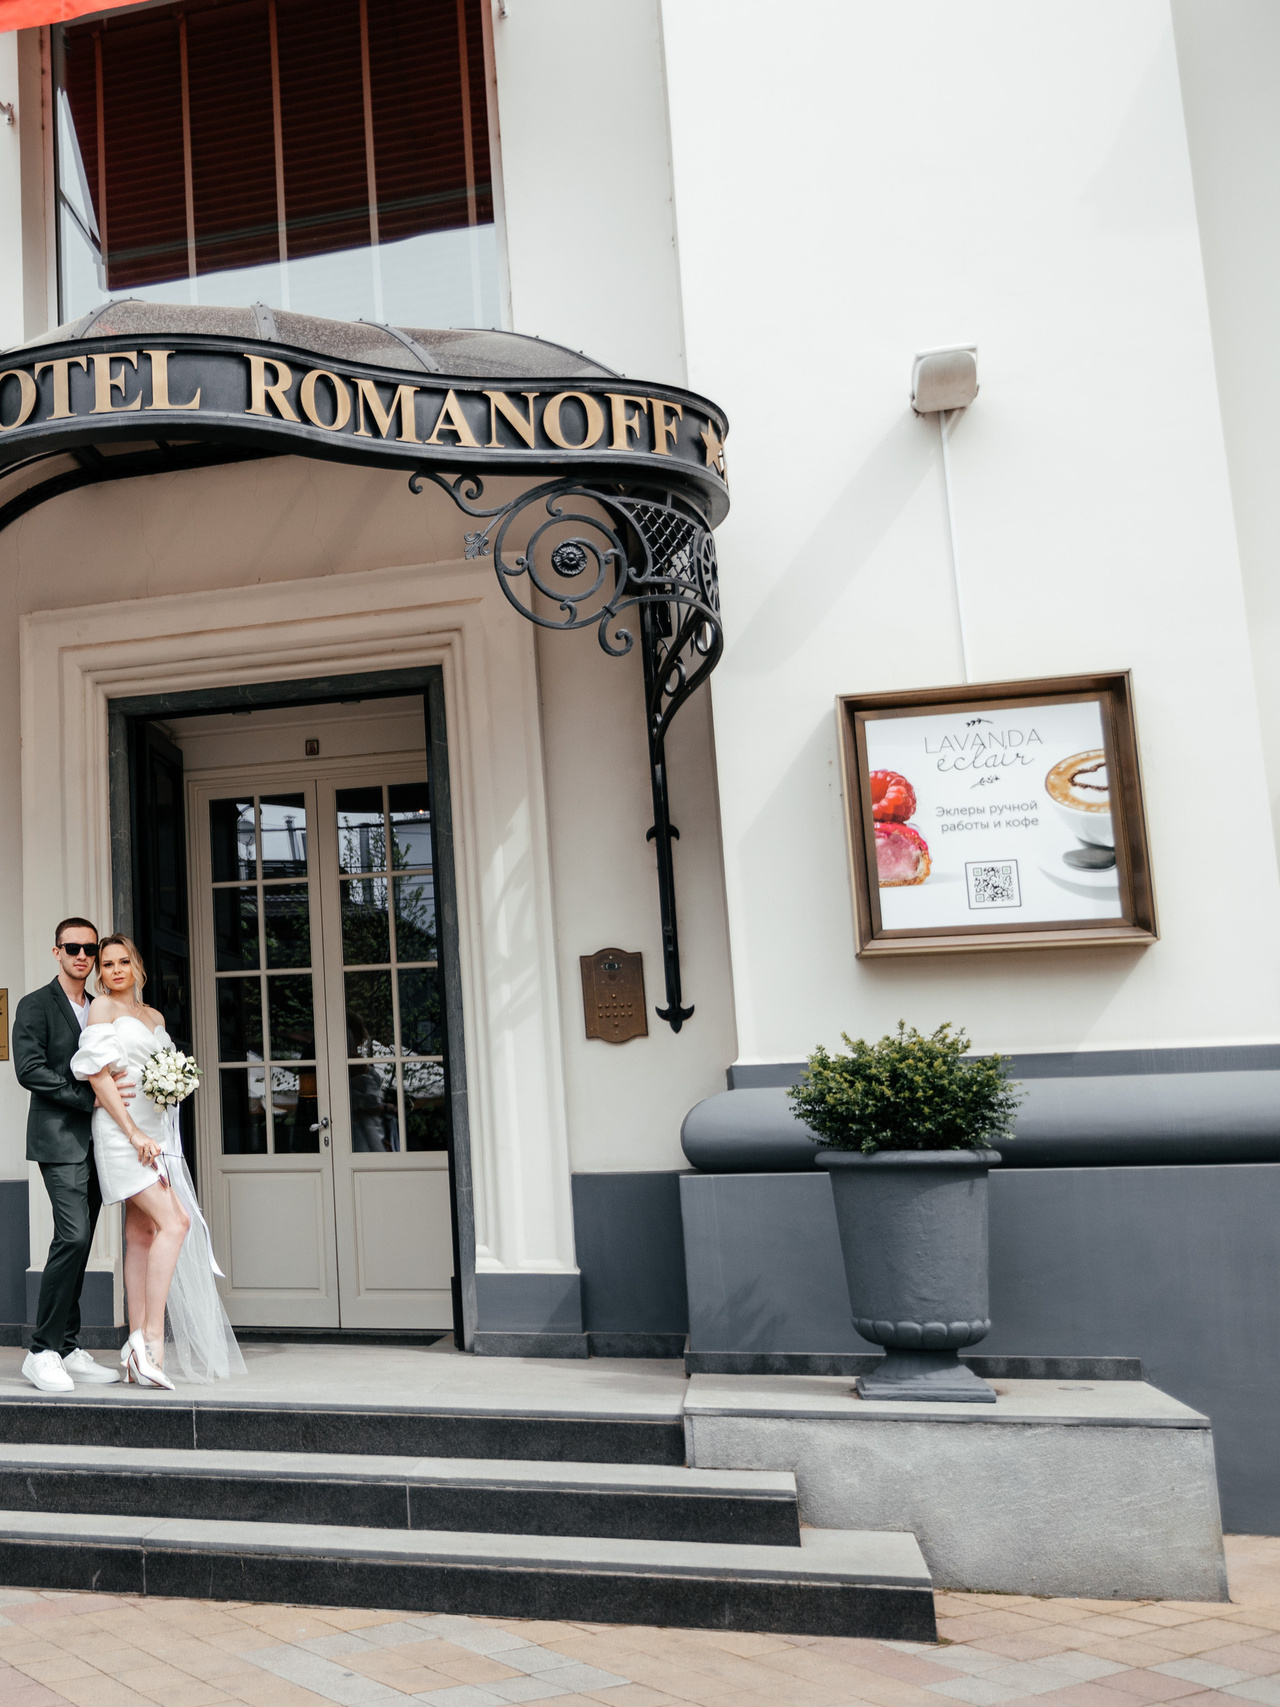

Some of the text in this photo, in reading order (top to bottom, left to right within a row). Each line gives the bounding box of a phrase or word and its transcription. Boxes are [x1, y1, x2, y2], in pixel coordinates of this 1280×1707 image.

[243, 353, 684, 457] ROMANOFF
[924, 728, 1044, 754] LAVANDA
[935, 800, 1038, 818] Эклеры ручной
[941, 816, 1040, 834] работы и кофе
